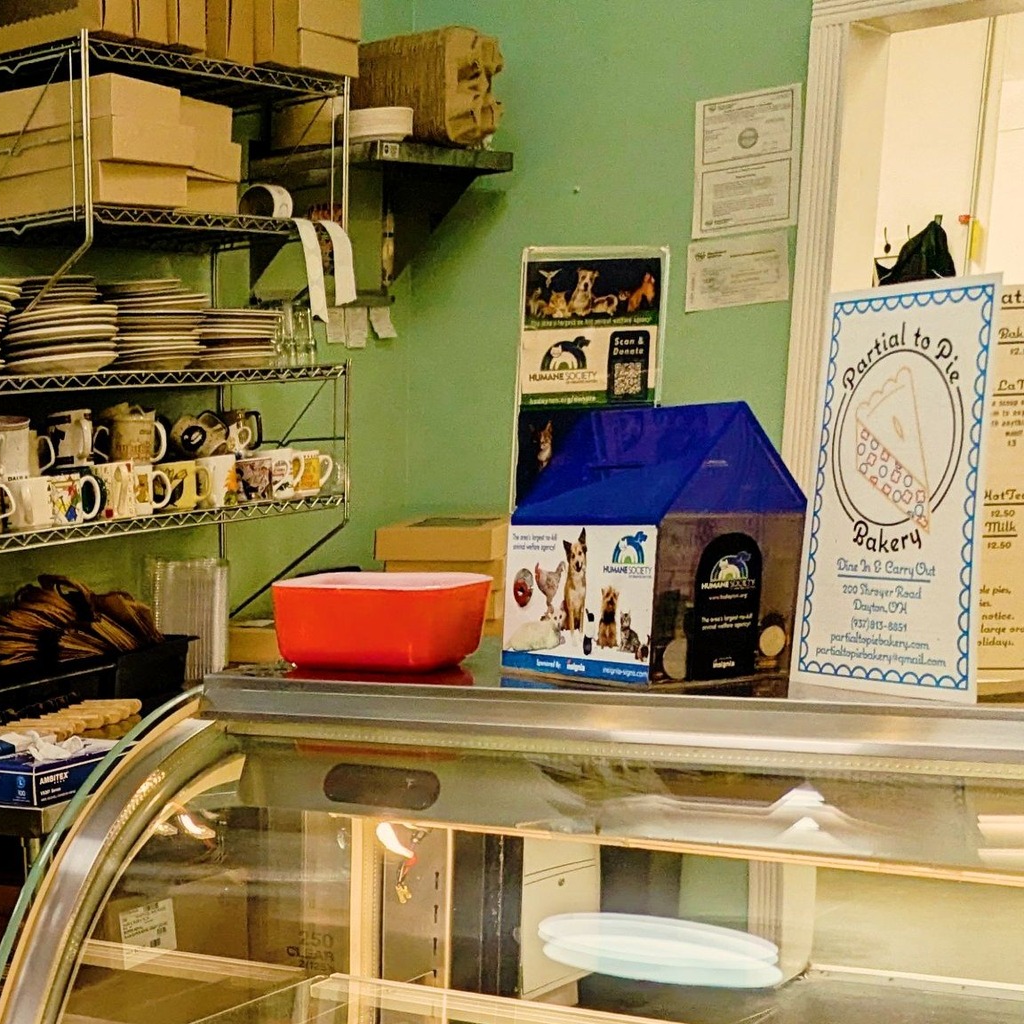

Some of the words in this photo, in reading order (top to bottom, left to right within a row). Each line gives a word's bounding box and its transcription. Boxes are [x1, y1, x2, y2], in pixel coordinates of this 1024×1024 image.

[614, 336, 635, 346] Scan
[638, 336, 644, 345] &
[613, 347, 644, 356] Donate
[842, 322, 906, 390] Partial
[914, 327, 930, 350] to
[935, 338, 960, 385] Pie
[529, 373, 564, 382] HUMANE
[565, 371, 598, 380] SOCIETY
[991, 509, 1016, 518] $2.50
[984, 521, 1017, 533] Milk
[852, 520, 923, 553] Bakery
[987, 541, 1012, 550] $2.50
[603, 565, 628, 574] HUMANE
[628, 567, 652, 575] SOCIETY
[837, 557, 858, 571] Dine
[860, 558, 871, 572] In
[874, 560, 882, 573] &
[885, 560, 914, 579] Carry
[916, 561, 935, 576] Out
[701, 581, 729, 590] HUMANE
[843, 584, 858, 594] 200
[860, 583, 894, 599] Shroyer
[895, 585, 922, 600] Road
[853, 598, 887, 615] Dayton,
[888, 601, 907, 614] OH
[982, 611, 1015, 621] notice.
[980, 623, 1006, 635] large
[830, 631, 930, 651] partialtopiebakery.com
[39, 771, 70, 785] AMBITEX
